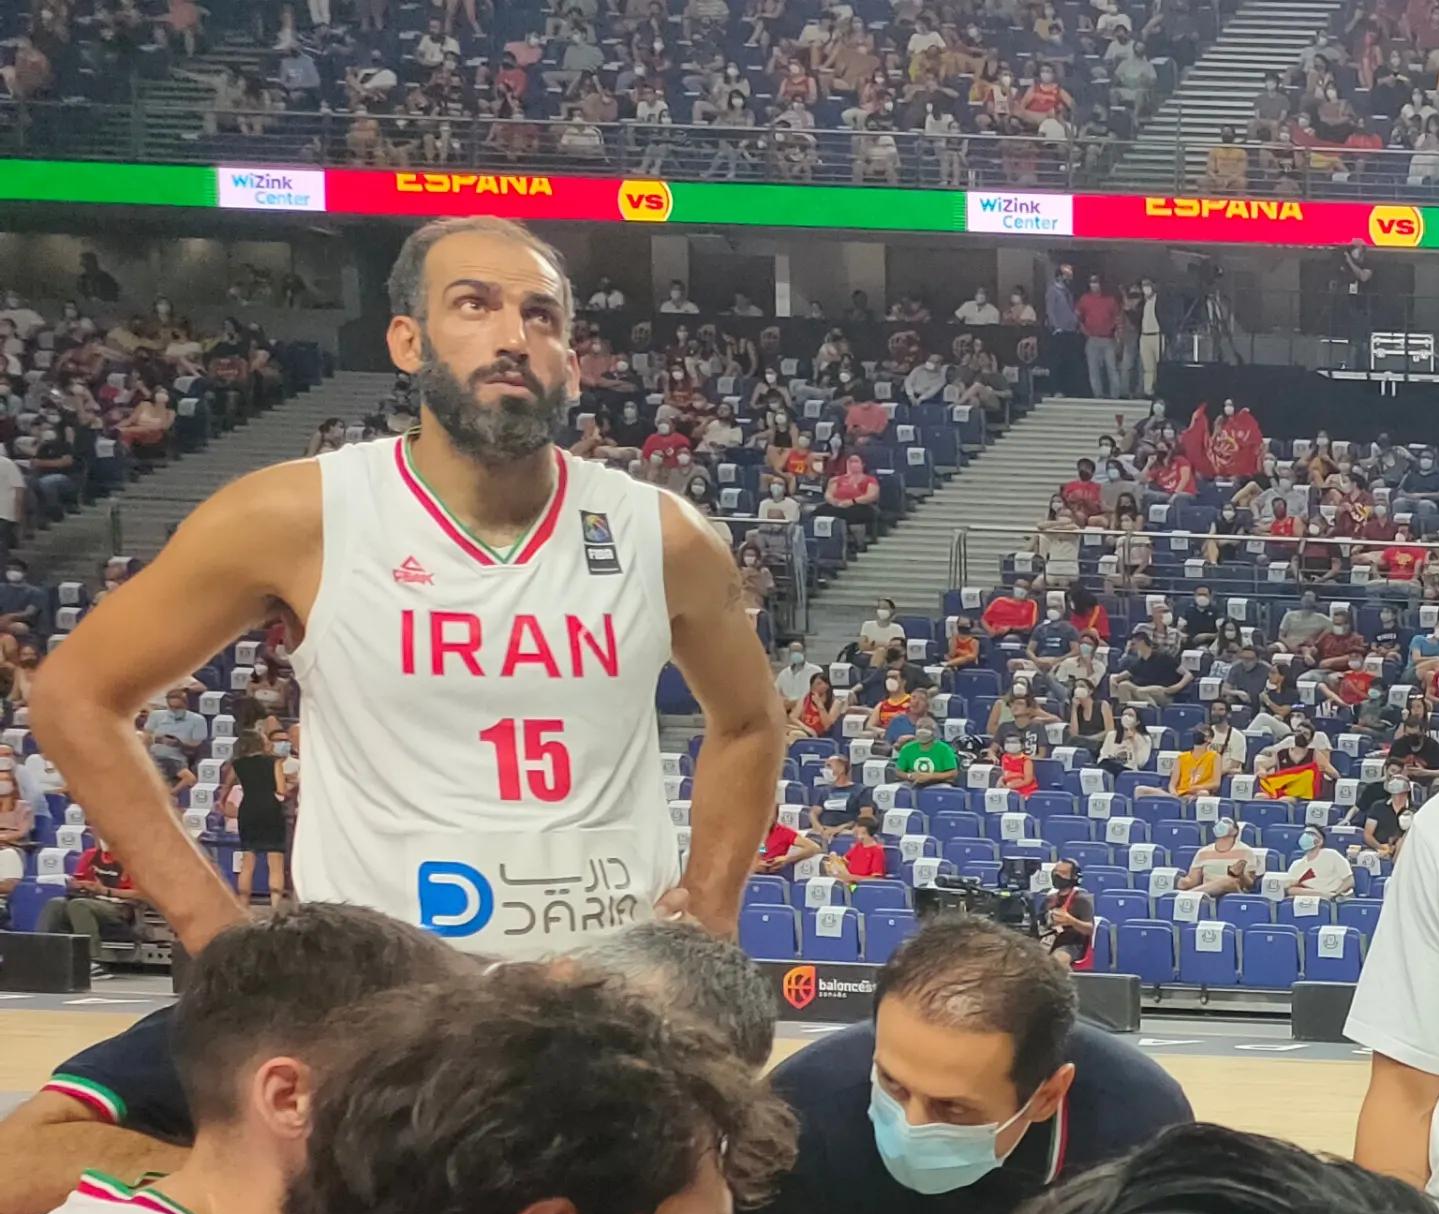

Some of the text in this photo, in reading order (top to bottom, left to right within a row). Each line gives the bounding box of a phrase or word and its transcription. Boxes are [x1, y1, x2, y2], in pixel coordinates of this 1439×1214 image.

[231, 172, 293, 190] WiZink
[254, 190, 310, 206] Center
[626, 193, 664, 210] VS
[980, 197, 1041, 214] WiZink
[1002, 214, 1058, 231] Center
[1376, 218, 1415, 235] VS
[401, 609, 619, 678] IRAN
[479, 717, 573, 803] 15
